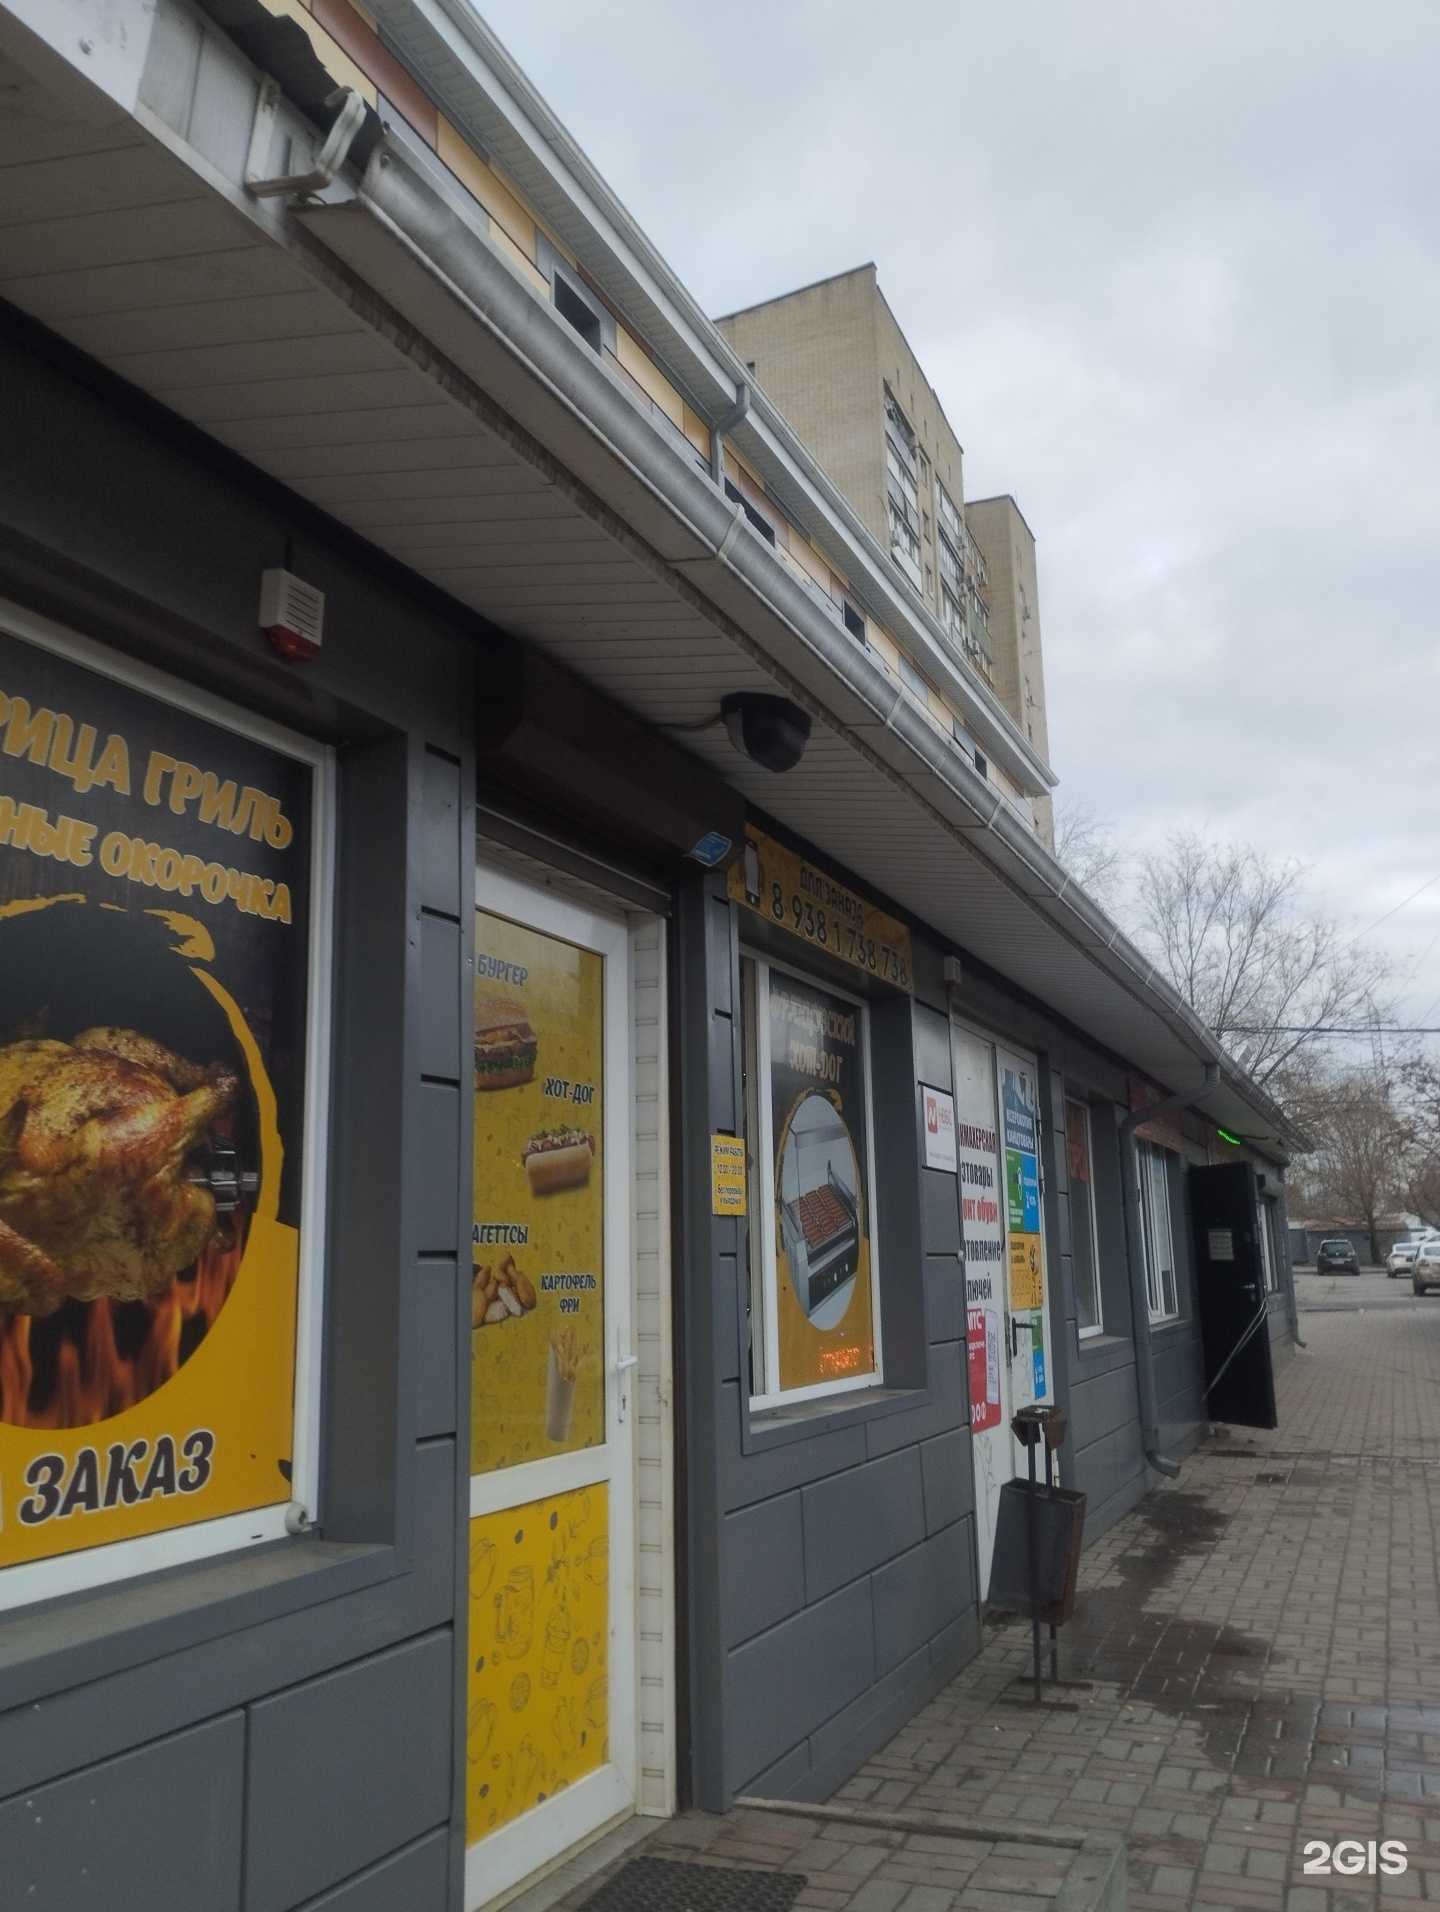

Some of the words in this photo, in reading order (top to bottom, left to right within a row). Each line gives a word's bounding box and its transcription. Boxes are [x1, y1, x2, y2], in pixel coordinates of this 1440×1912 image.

[143, 751, 293, 849] ГРИЛЬ
[100, 831, 292, 925] ОКОРОЧКА
[772, 881, 784, 921] 8
[792, 895, 827, 944] 938
[834, 921, 841, 953] 1
[849, 929, 876, 970] 738
[882, 946, 909, 987] 738
[477, 953, 528, 987] БУРГЕР
[544, 1077, 595, 1105] ХОТ-ДОГ
[541, 1275, 597, 1291] КАРТОФЕЛЬ
[560, 1298, 580, 1312] ФРИ
[19, 1428, 214, 1527] ЗАКАЗ
